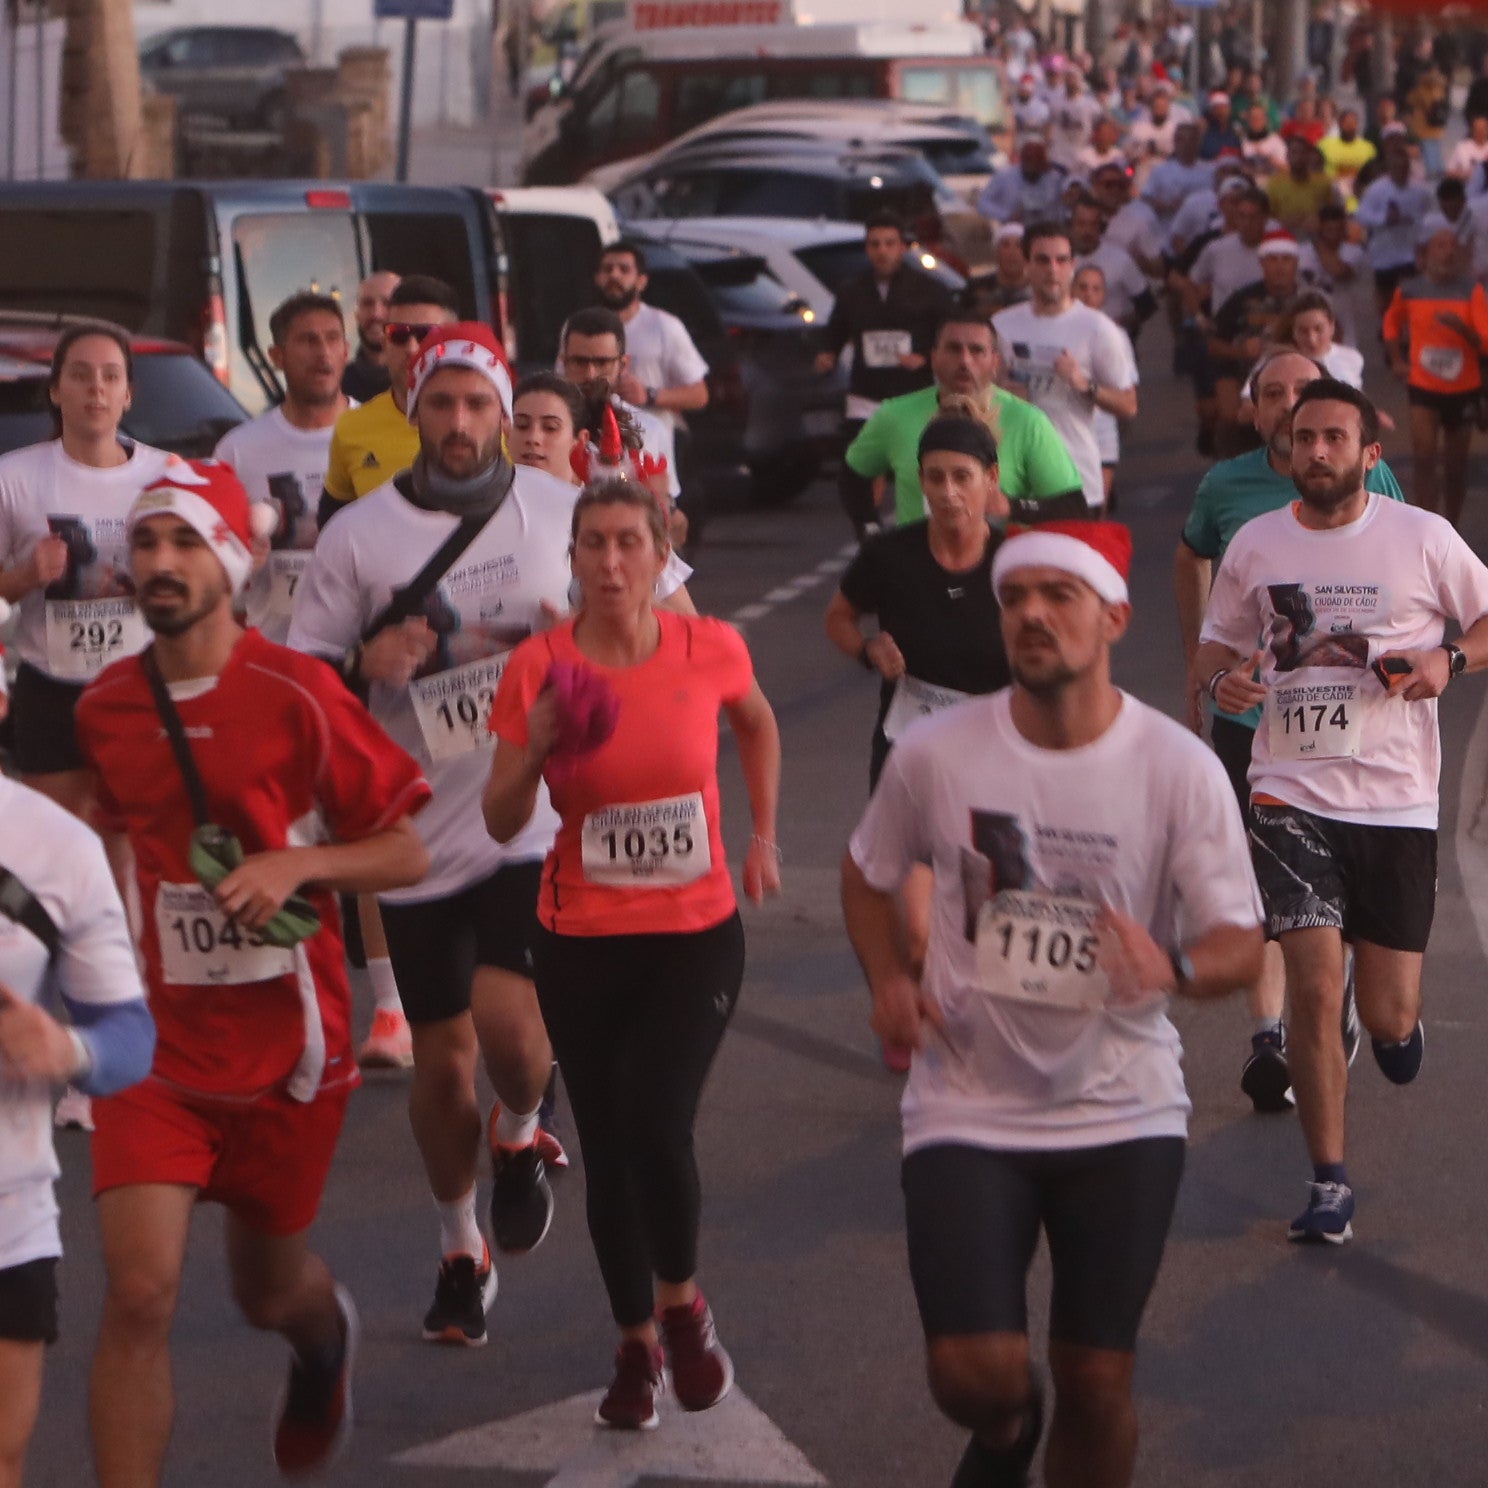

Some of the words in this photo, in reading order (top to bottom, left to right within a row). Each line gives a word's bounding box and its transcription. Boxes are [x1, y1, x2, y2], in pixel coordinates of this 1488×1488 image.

[1315, 585, 1332, 595] SAN
[1335, 586, 1379, 595] SILVESTRE
[1314, 597, 1342, 607] CIUDAD
[1344, 597, 1353, 607] DE
[69, 620, 123, 649] 292
[1293, 685, 1354, 694] SILVESTRE
[1306, 692, 1320, 702] DE
[1283, 703, 1349, 734] 1174
[601, 823, 693, 859] 1035
[996, 922, 1100, 975] 1105
